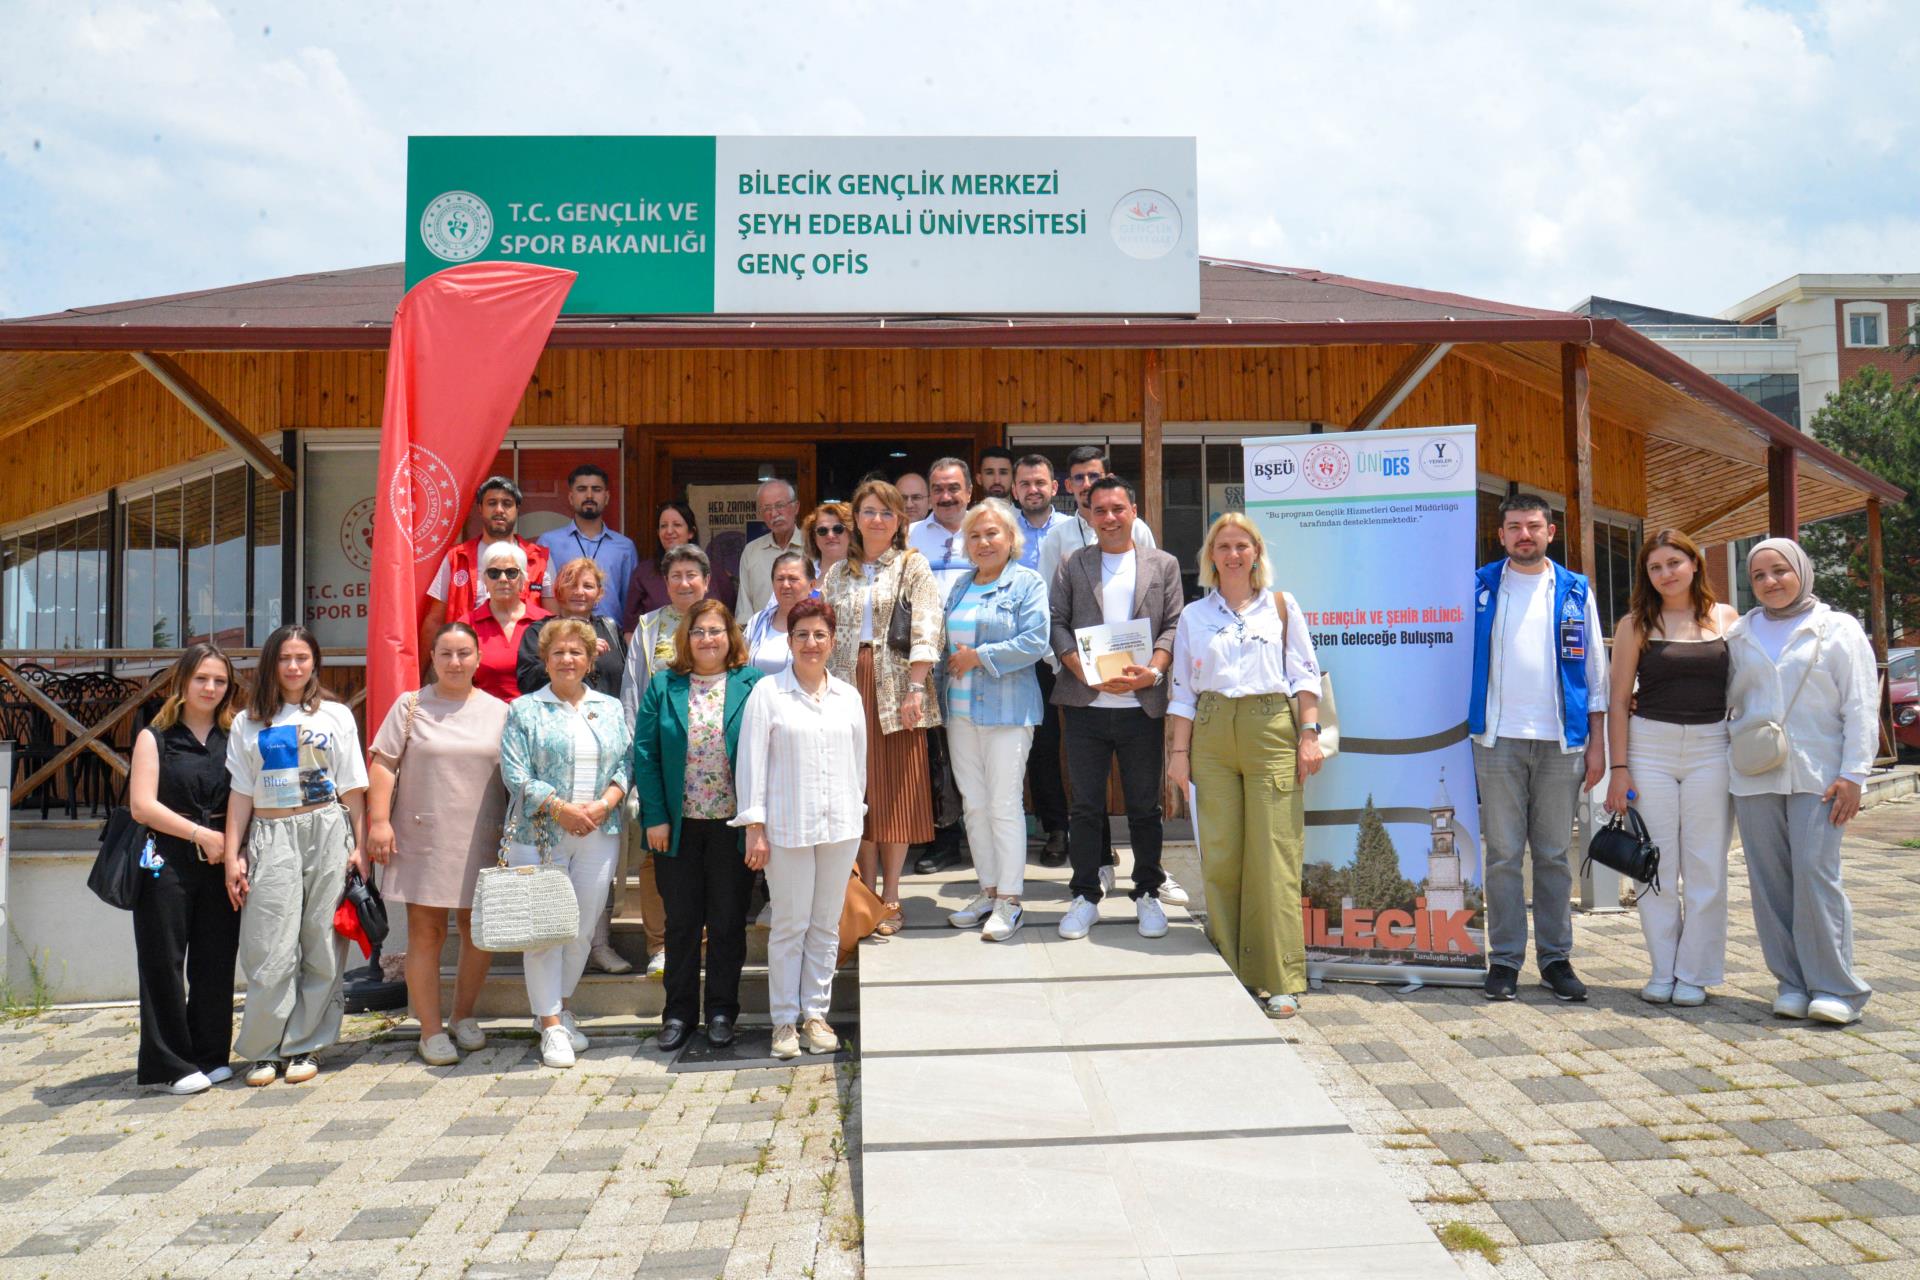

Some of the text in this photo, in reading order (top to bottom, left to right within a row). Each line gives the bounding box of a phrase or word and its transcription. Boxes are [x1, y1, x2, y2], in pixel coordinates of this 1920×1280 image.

[738, 169, 1059, 201] BİLECİK GENÇLİK MERKEZİ
[508, 197, 698, 227] T.C. GENÇLİK VE
[737, 208, 1087, 240] ŞEYH EDEBALİ ÜNİVERSİTESİ
[500, 229, 706, 255] SPOR BAKANLIĞI
[736, 248, 869, 280] GENÇ OFİS
[1434, 443, 1446, 458] Y
[1254, 459, 1293, 480] BŞEÜ
[1383, 456, 1410, 476] DES
[708, 501, 757, 513] HER ZAMAN
[1281, 510, 1313, 520] program
[1315, 508, 1345, 517] Gençlik
[1346, 505, 1388, 515] Hizmetleri
[1389, 504, 1413, 513] Genel
[1415, 503, 1459, 513] Müdürlüğü
[1299, 518, 1341, 528] tarafından
[307, 583, 371, 599] T.C. GE
[306, 604, 351, 621] SPOR
[1322, 608, 1367, 629] GENÇLİK
[1370, 610, 1384, 624] VE
[1386, 606, 1419, 628] ŞEHİR
[1422, 605, 1464, 624] BİLİNCİ:
[1341, 630, 1397, 647] Geleceğe
[1400, 630, 1454, 648] Buluşma
[263, 776, 288, 788] Blue
